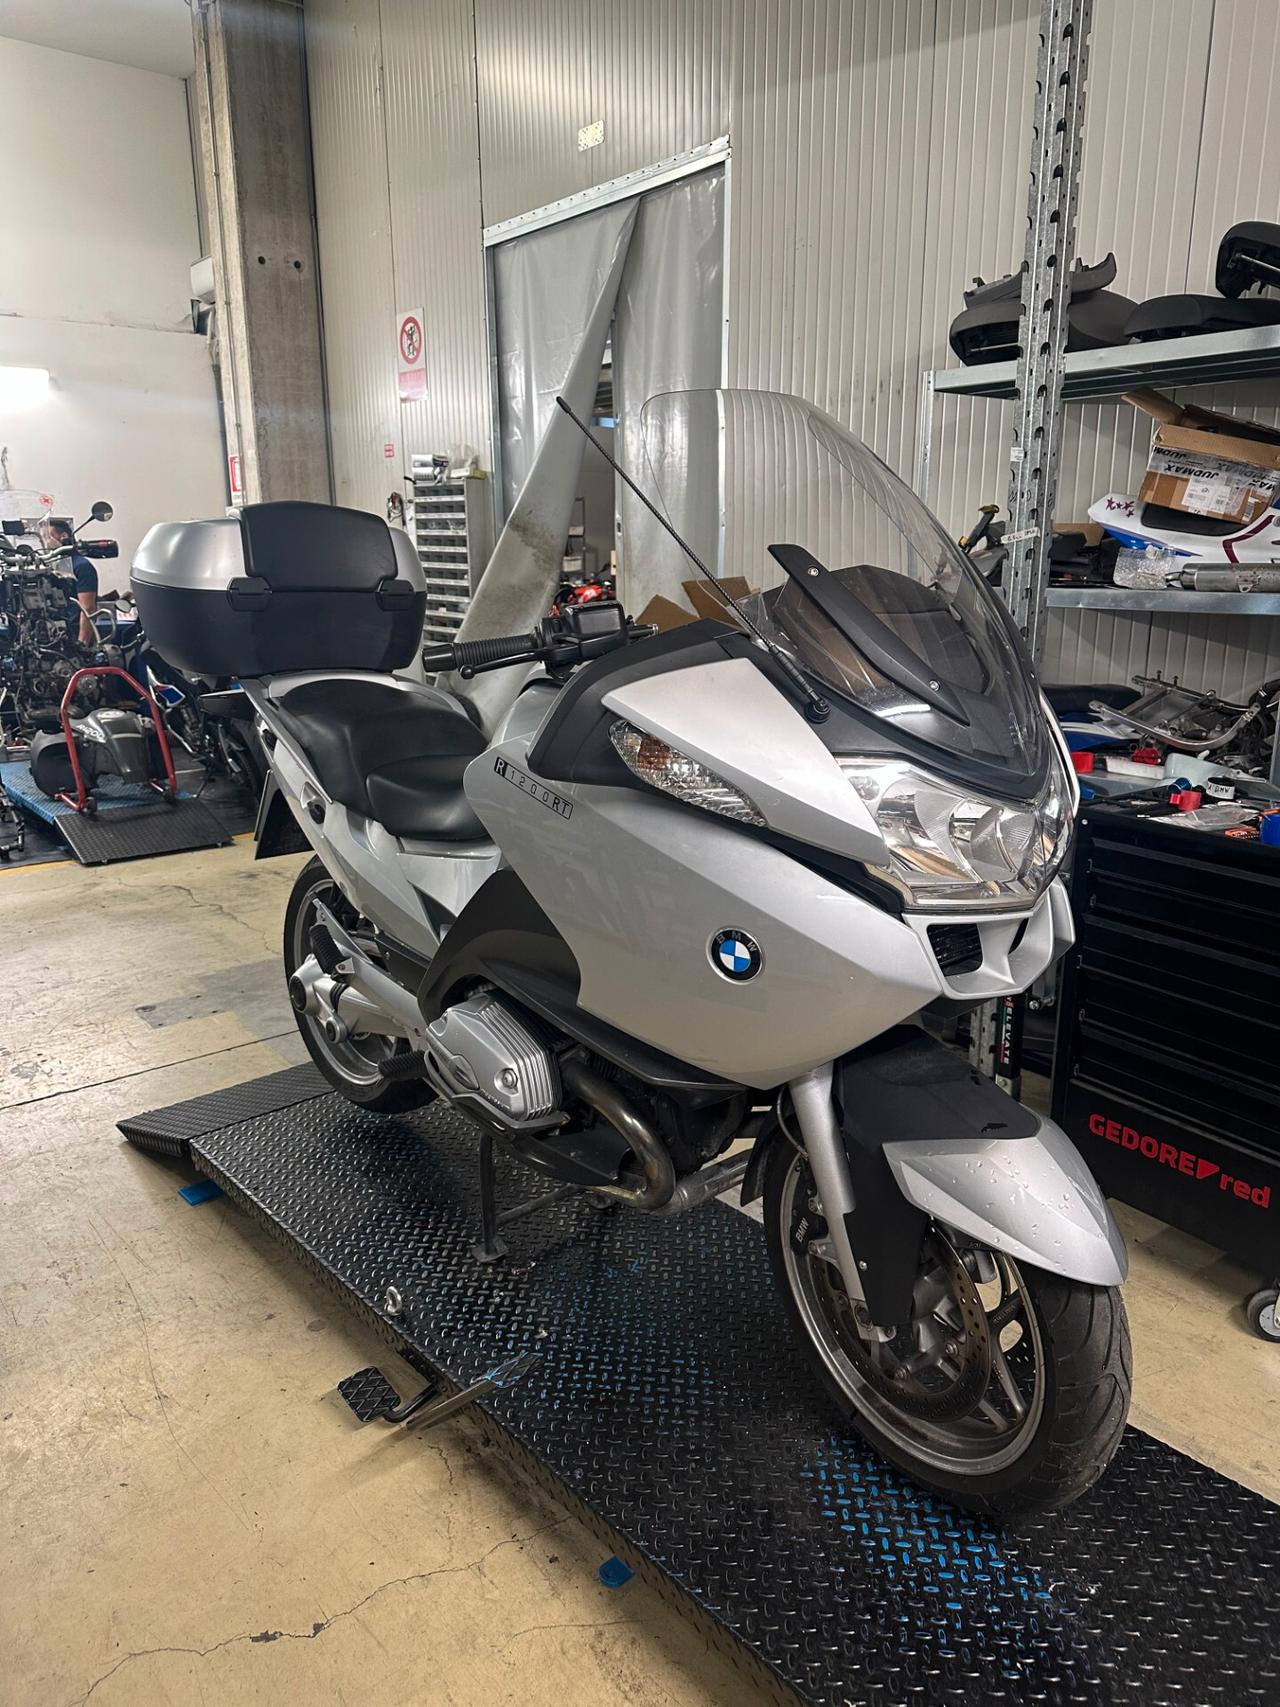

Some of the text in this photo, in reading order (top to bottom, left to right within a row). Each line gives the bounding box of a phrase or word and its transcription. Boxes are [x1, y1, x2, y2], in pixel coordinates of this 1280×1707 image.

[1164, 463, 1219, 479] JUDMAX
[716, 930, 758, 953] BMW
[1003, 1007, 1013, 1065] ELEVATE
[1088, 1113, 1272, 1209] GEDORE red
[795, 1217, 809, 1243] BMW
